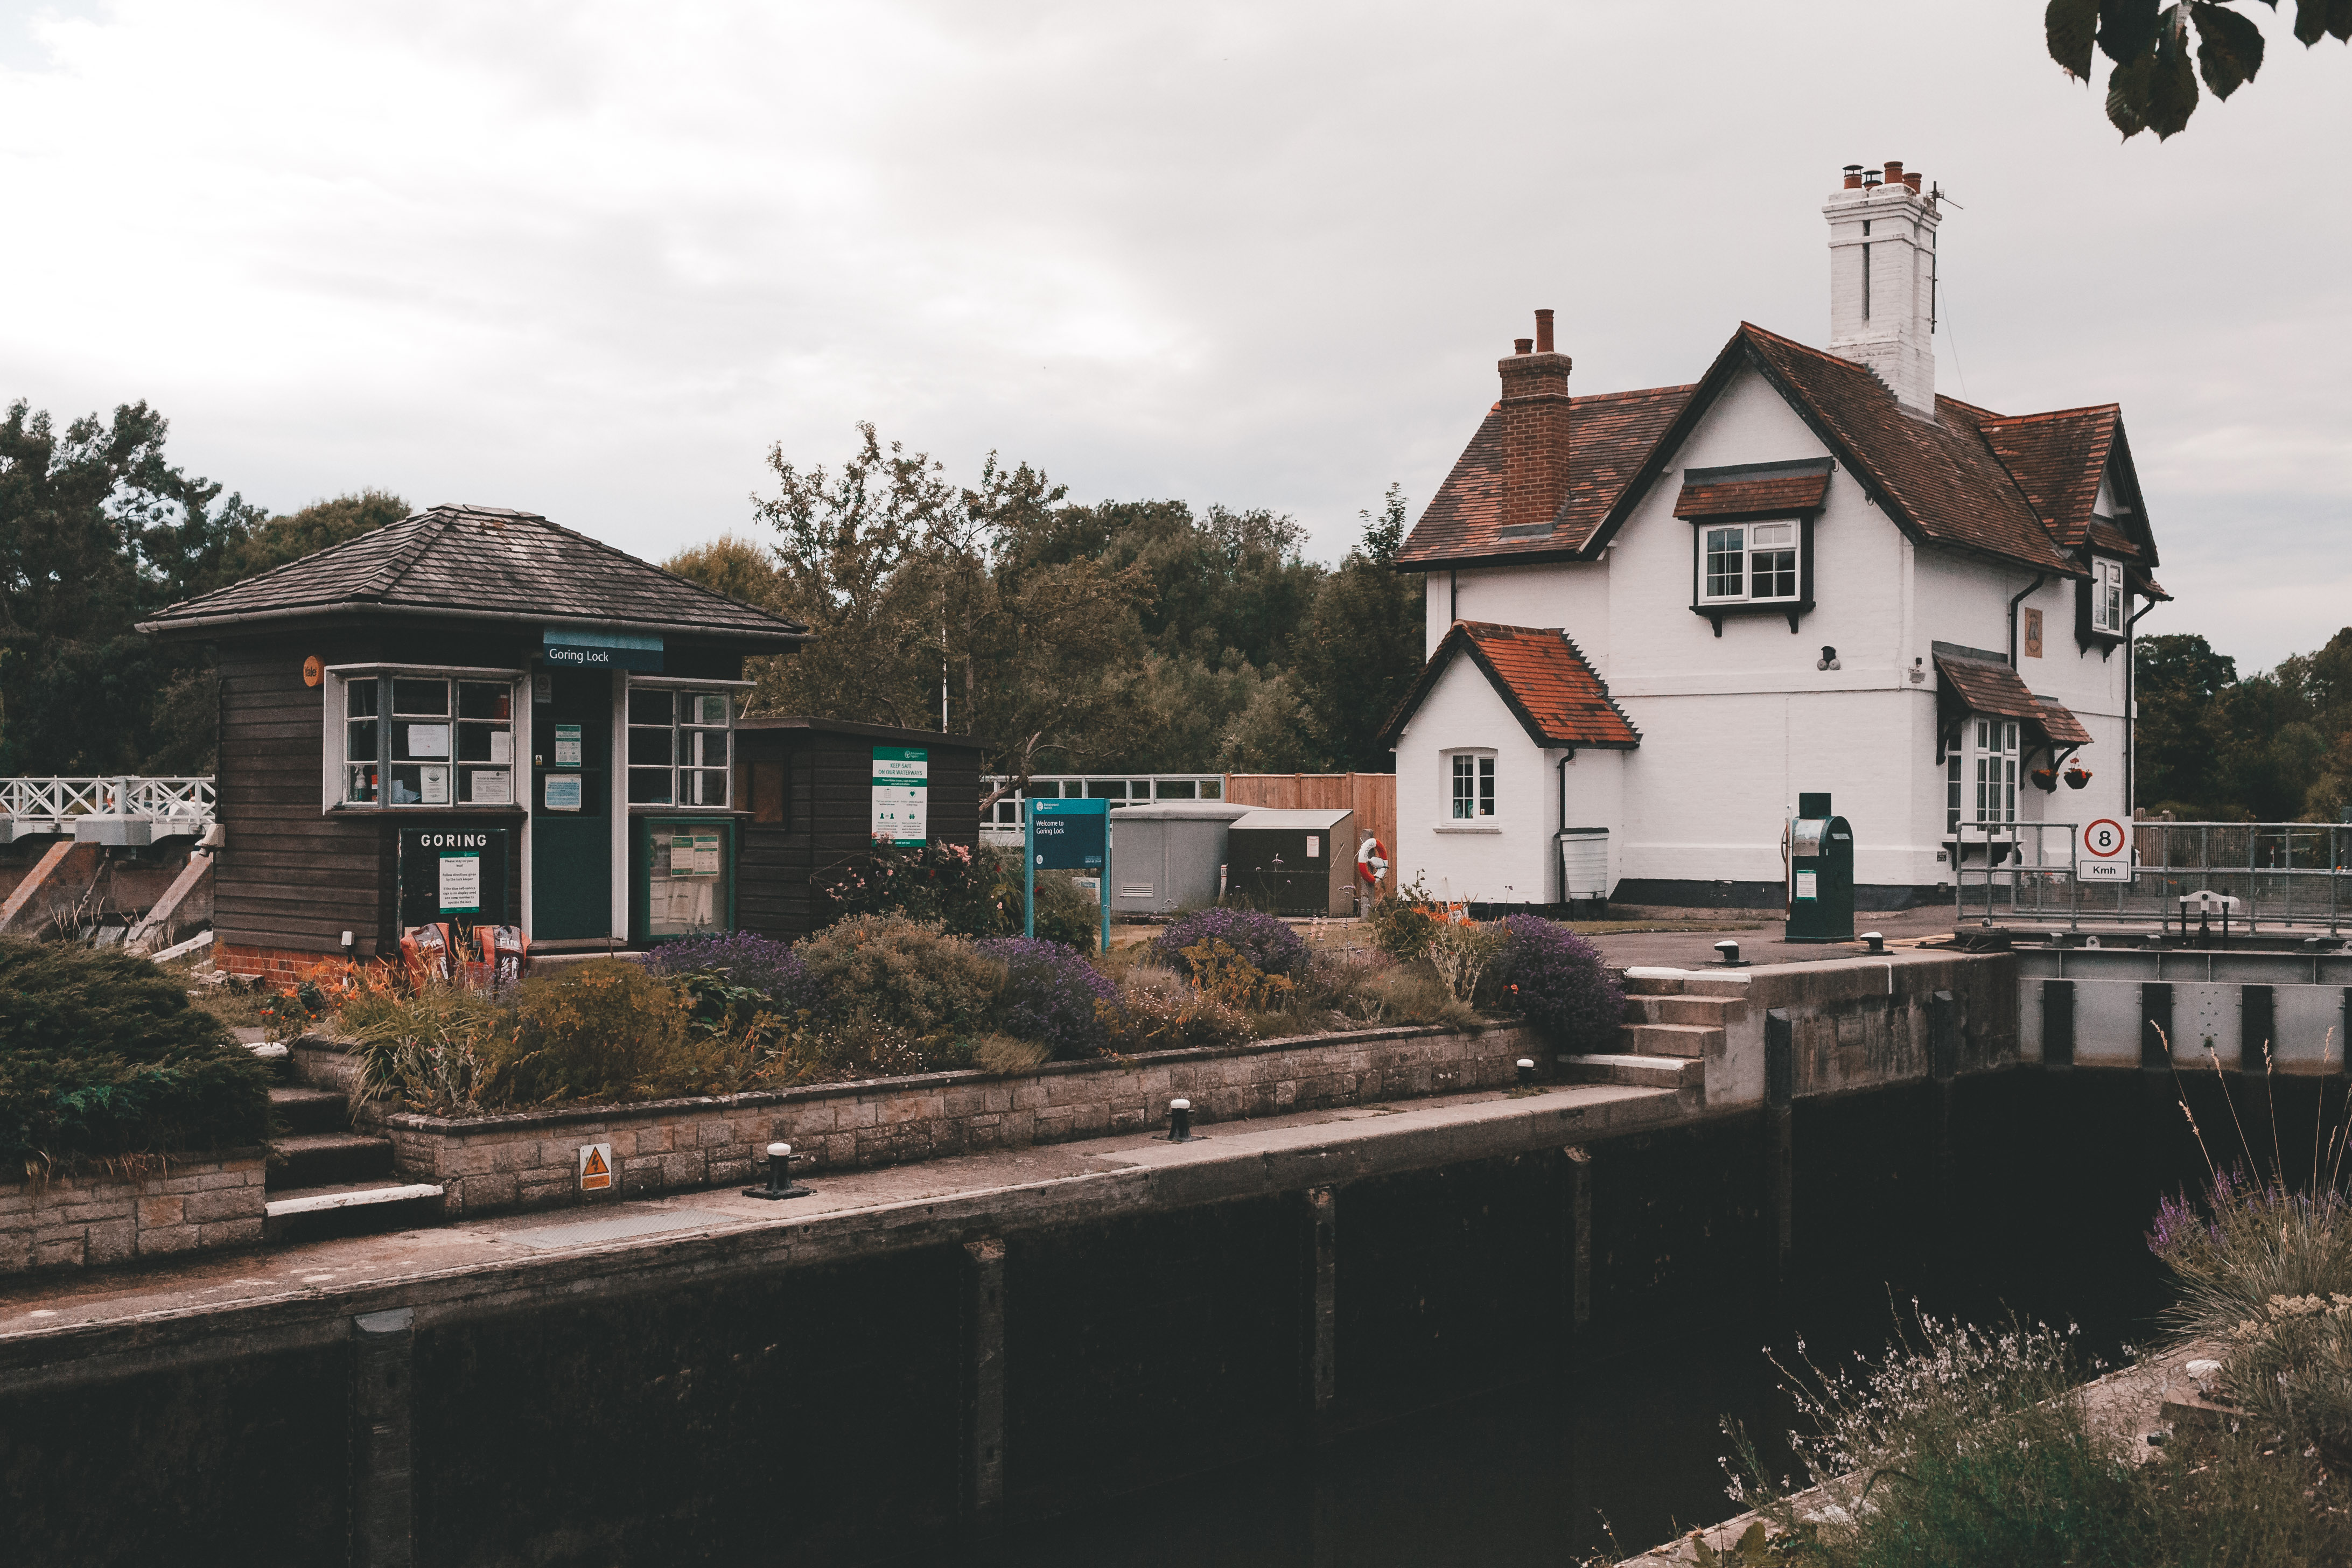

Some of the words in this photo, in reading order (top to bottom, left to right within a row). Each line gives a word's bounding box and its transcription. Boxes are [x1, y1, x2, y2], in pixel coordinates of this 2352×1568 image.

[549, 648, 584, 663] Goring
[587, 650, 608, 662] Lock
[305, 666, 317, 677] Yale
[1036, 828, 1053, 836] Goring
[421, 834, 486, 847] GORING
[2098, 830, 2111, 847] 8
[1364, 841, 1374, 858] GORING
[2093, 866, 2116, 874] Kmh
[422, 937, 443, 948] Fire
[500, 937, 519, 948] Fire
